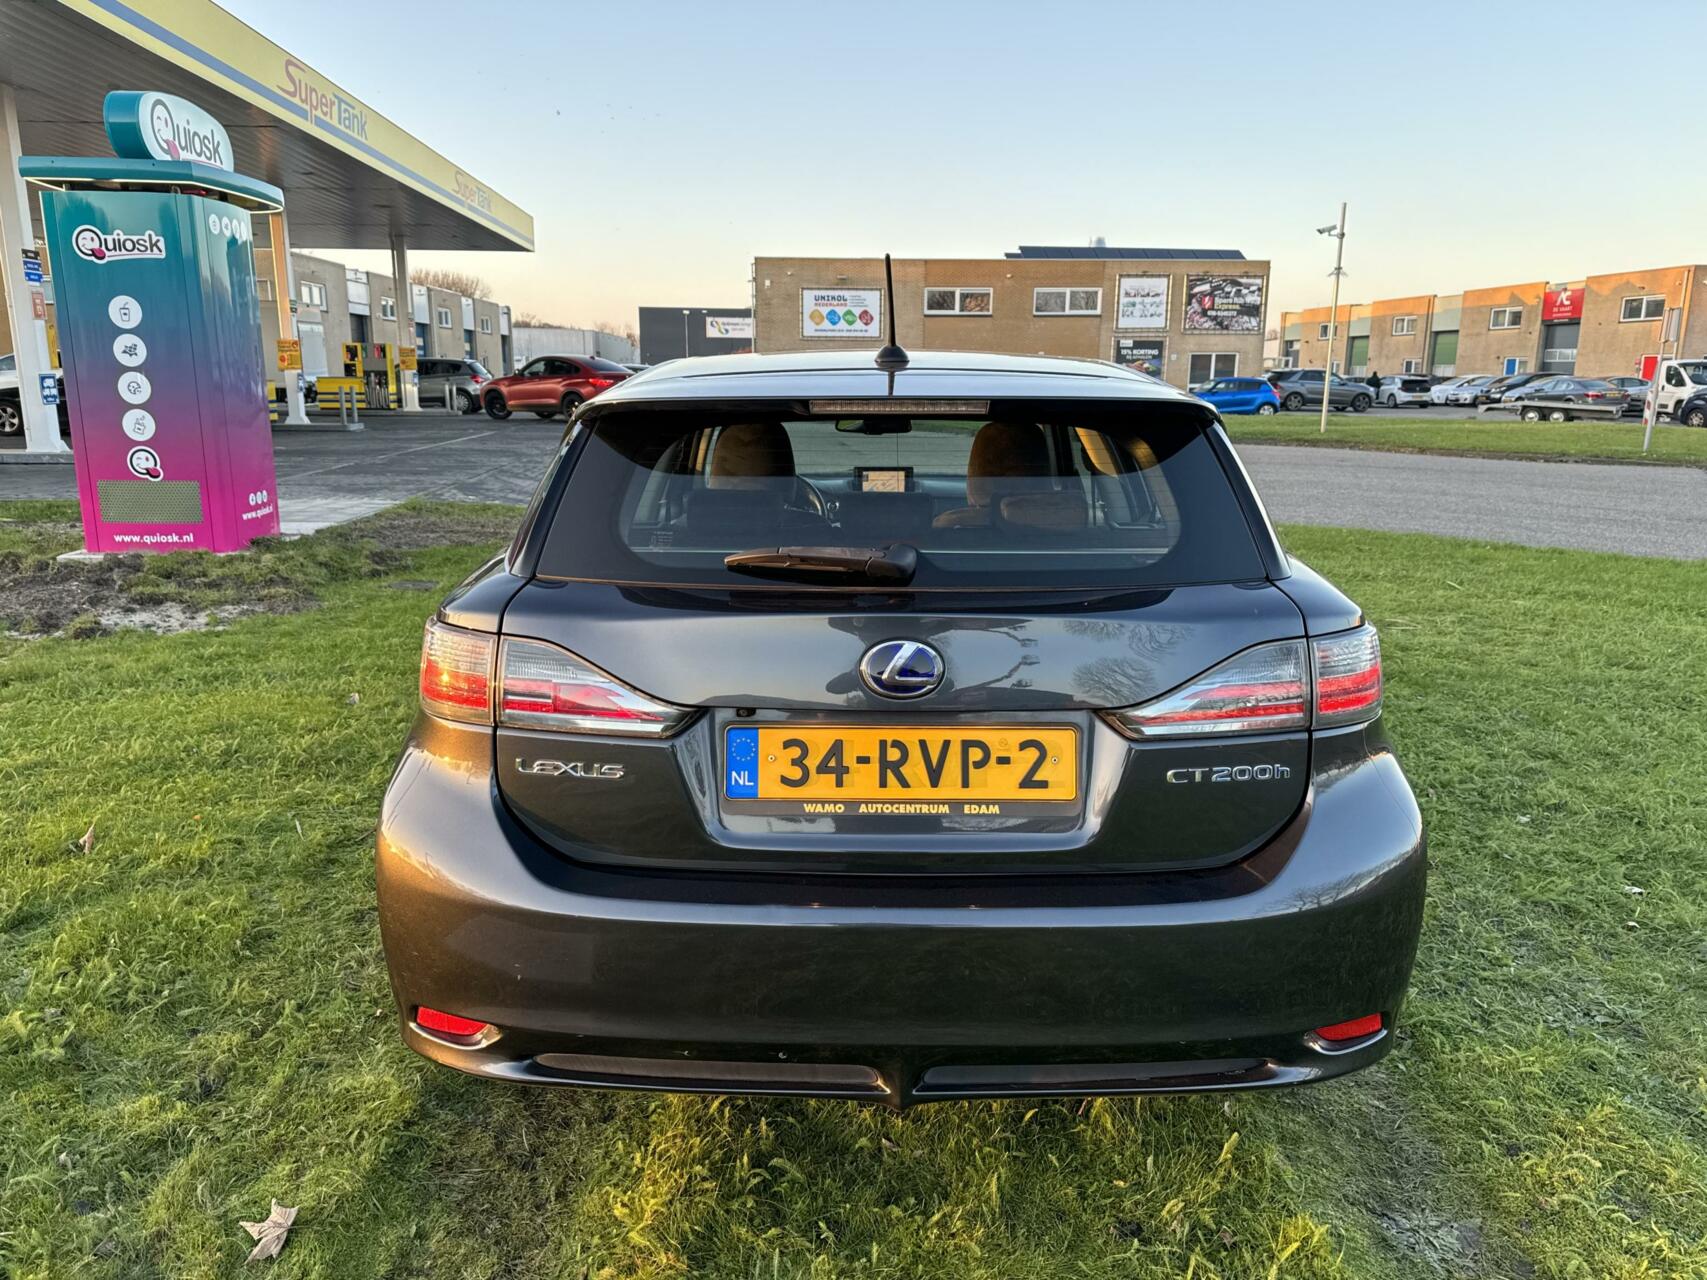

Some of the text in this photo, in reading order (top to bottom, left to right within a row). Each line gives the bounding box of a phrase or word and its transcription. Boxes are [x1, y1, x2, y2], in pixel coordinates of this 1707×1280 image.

[151, 99, 223, 165] Quiosk
[75, 228, 163, 259] Quiosk
[113, 533, 194, 543] www.quiosk.nl
[515, 758, 625, 778] LEXUS
[779, 738, 1049, 789] 34-RVP-2
[731, 771, 754, 786] NL
[803, 803, 1000, 814] WAMO AUTOCENTRUM EDAM
